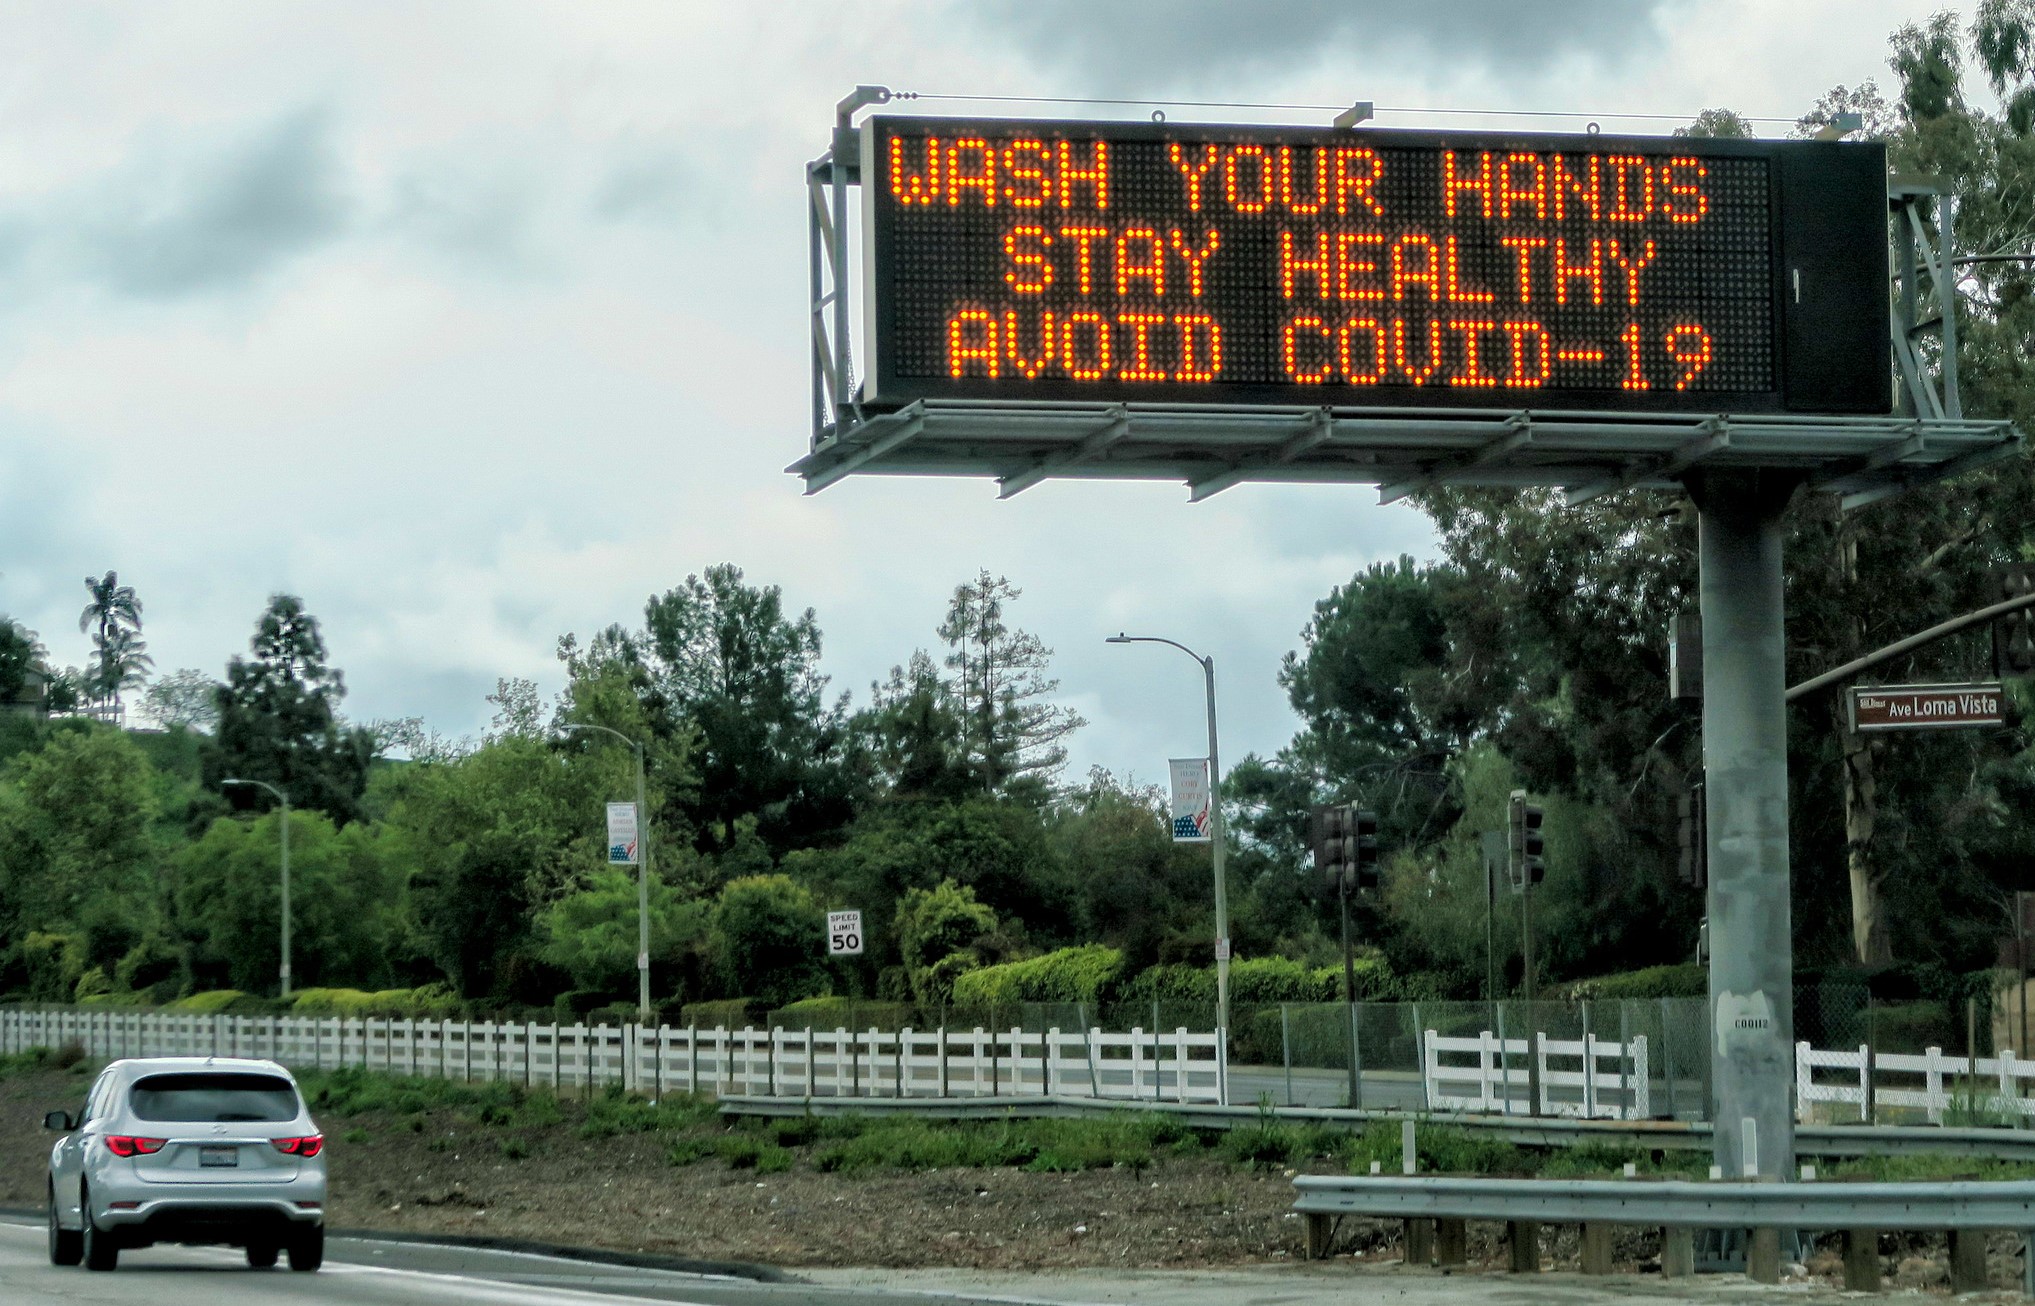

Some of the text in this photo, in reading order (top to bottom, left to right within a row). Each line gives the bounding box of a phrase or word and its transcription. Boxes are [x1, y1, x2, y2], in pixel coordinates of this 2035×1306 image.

[890, 136, 1707, 223] WASH YOUR HANDS
[1003, 224, 1655, 306] STAY HEALTHY
[948, 309, 1711, 390] AVOID COVID-19
[1889, 702, 1911, 717] Ave
[1914, 696, 1956, 716] Loma
[1958, 695, 1997, 715] Vista
[830, 914, 858, 922] SPEED
[833, 923, 856, 931] LIMIT
[832, 933, 859, 950] 50
